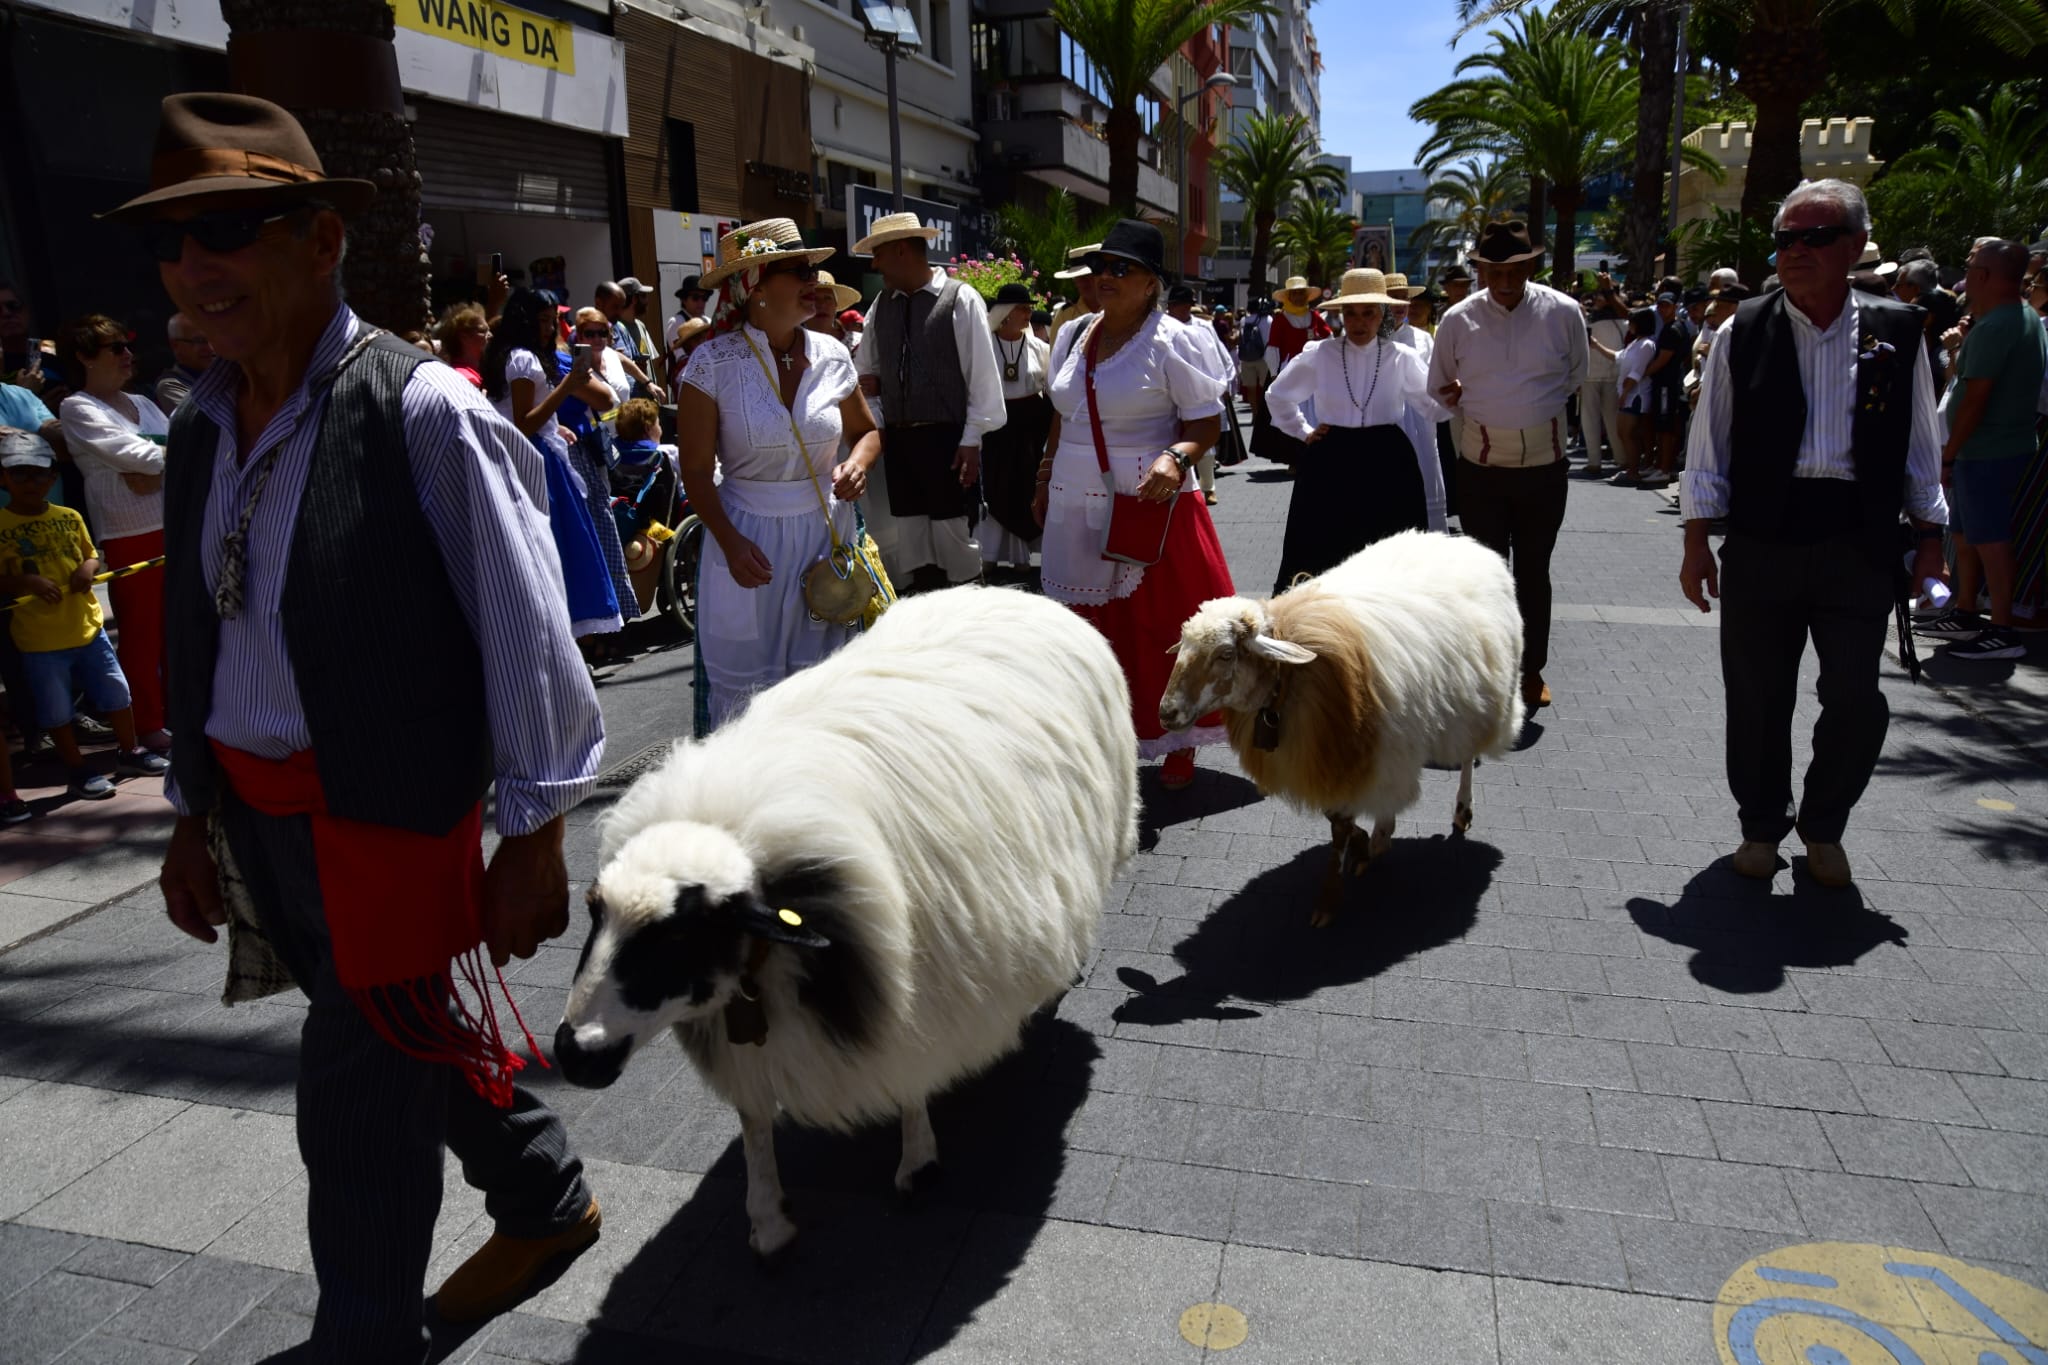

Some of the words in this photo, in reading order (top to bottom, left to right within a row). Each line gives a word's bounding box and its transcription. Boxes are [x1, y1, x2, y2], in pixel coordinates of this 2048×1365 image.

[418, 0, 510, 47] WANG
[521, 20, 559, 63] DA
[925, 217, 953, 252] OFF
